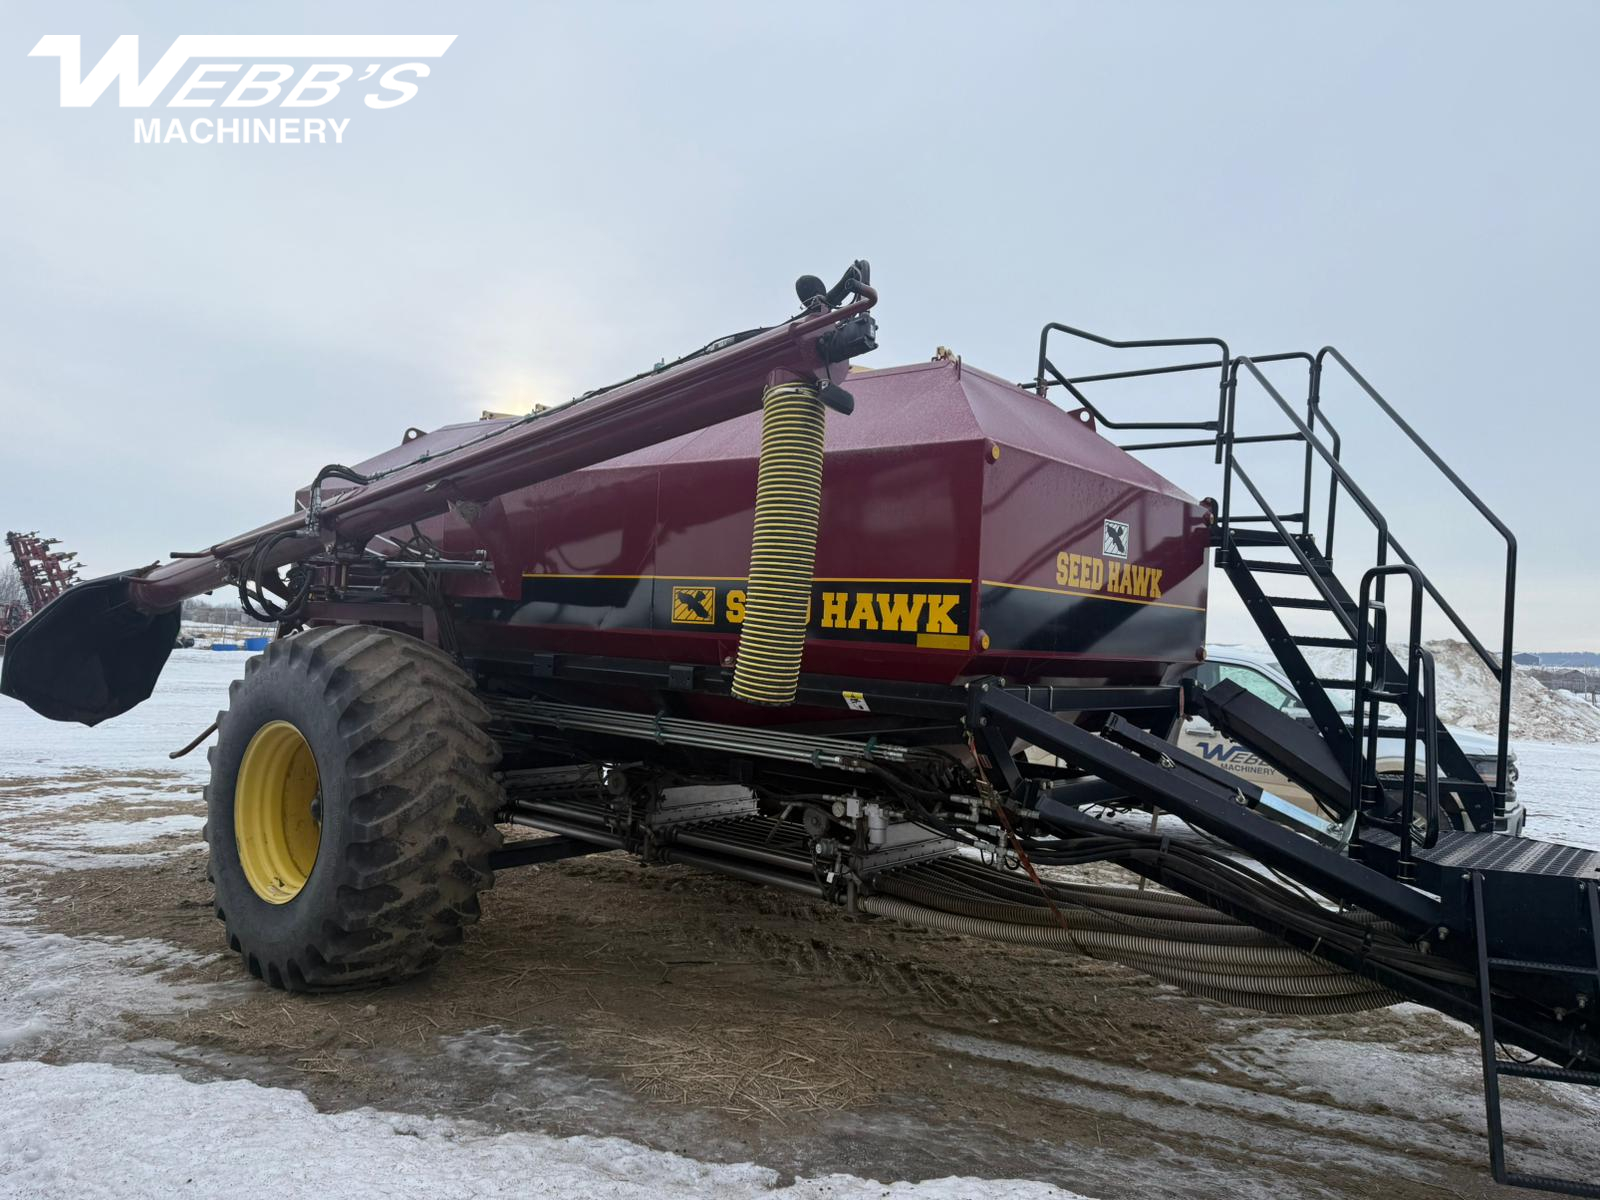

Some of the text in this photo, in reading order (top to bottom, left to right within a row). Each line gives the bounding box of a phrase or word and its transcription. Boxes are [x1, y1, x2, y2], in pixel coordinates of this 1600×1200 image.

[1056, 551, 1162, 598] SEED HAWK
[821, 592, 960, 633] HAWK
[1220, 763, 1275, 776] MACHINERY
